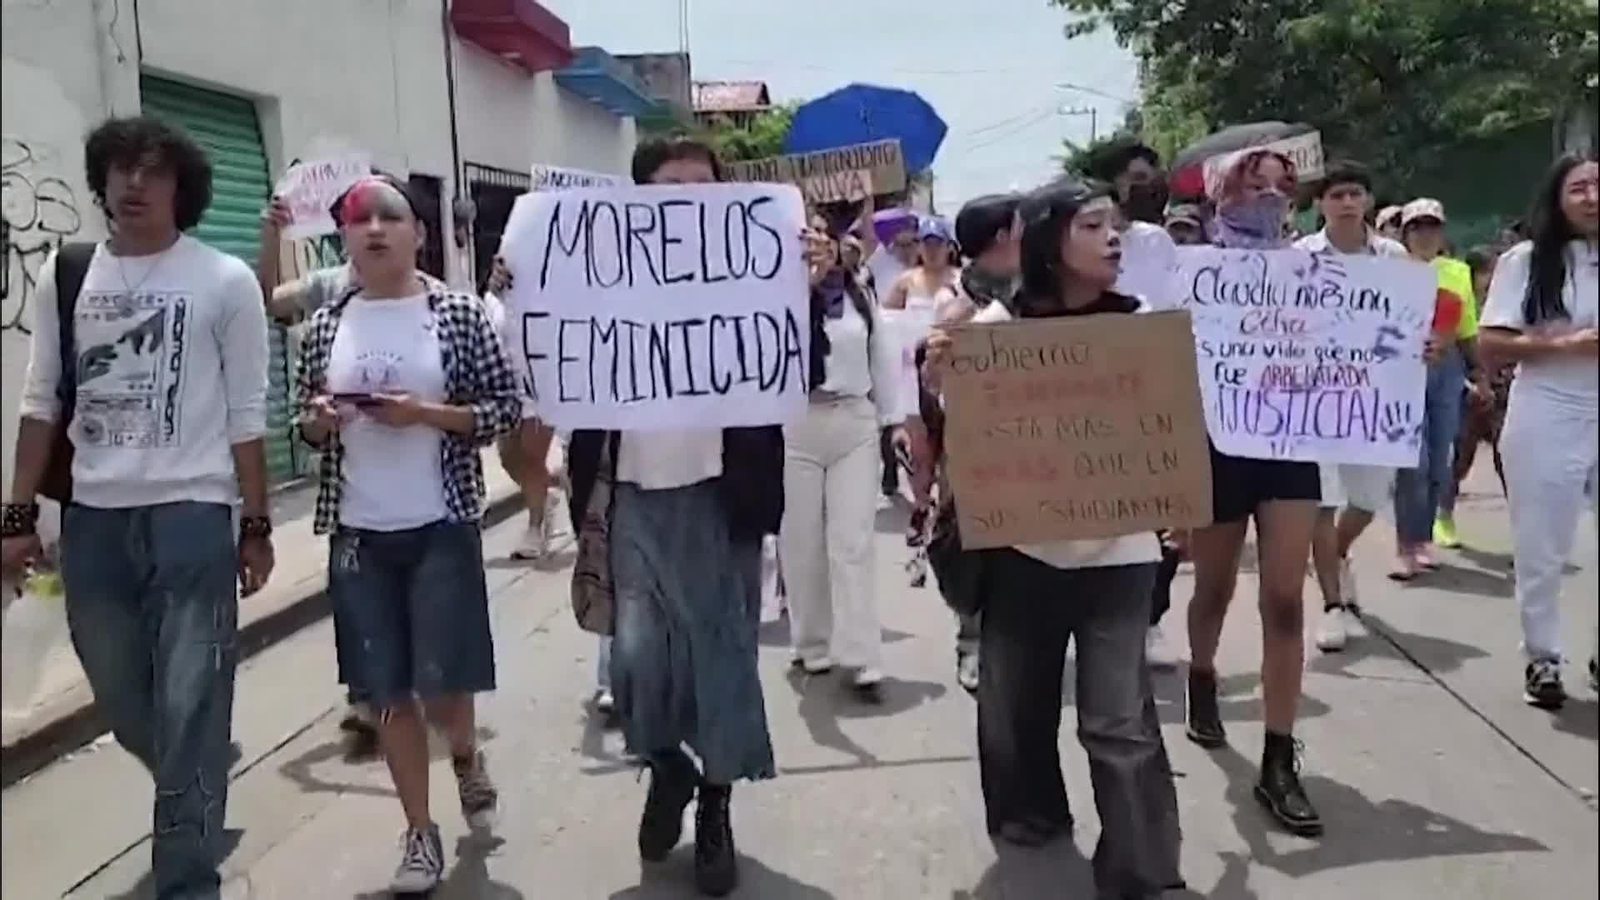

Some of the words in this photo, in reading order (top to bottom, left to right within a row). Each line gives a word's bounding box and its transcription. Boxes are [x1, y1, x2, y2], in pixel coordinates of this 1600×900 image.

[540, 196, 783, 290] MORELOS
[522, 307, 807, 404] FEMINICIDA
[1214, 361, 1248, 387] fue
[1220, 342, 1255, 358] una
[1262, 338, 1306, 359] vida
[1217, 383, 1380, 443] ¡JUSTICIA!
